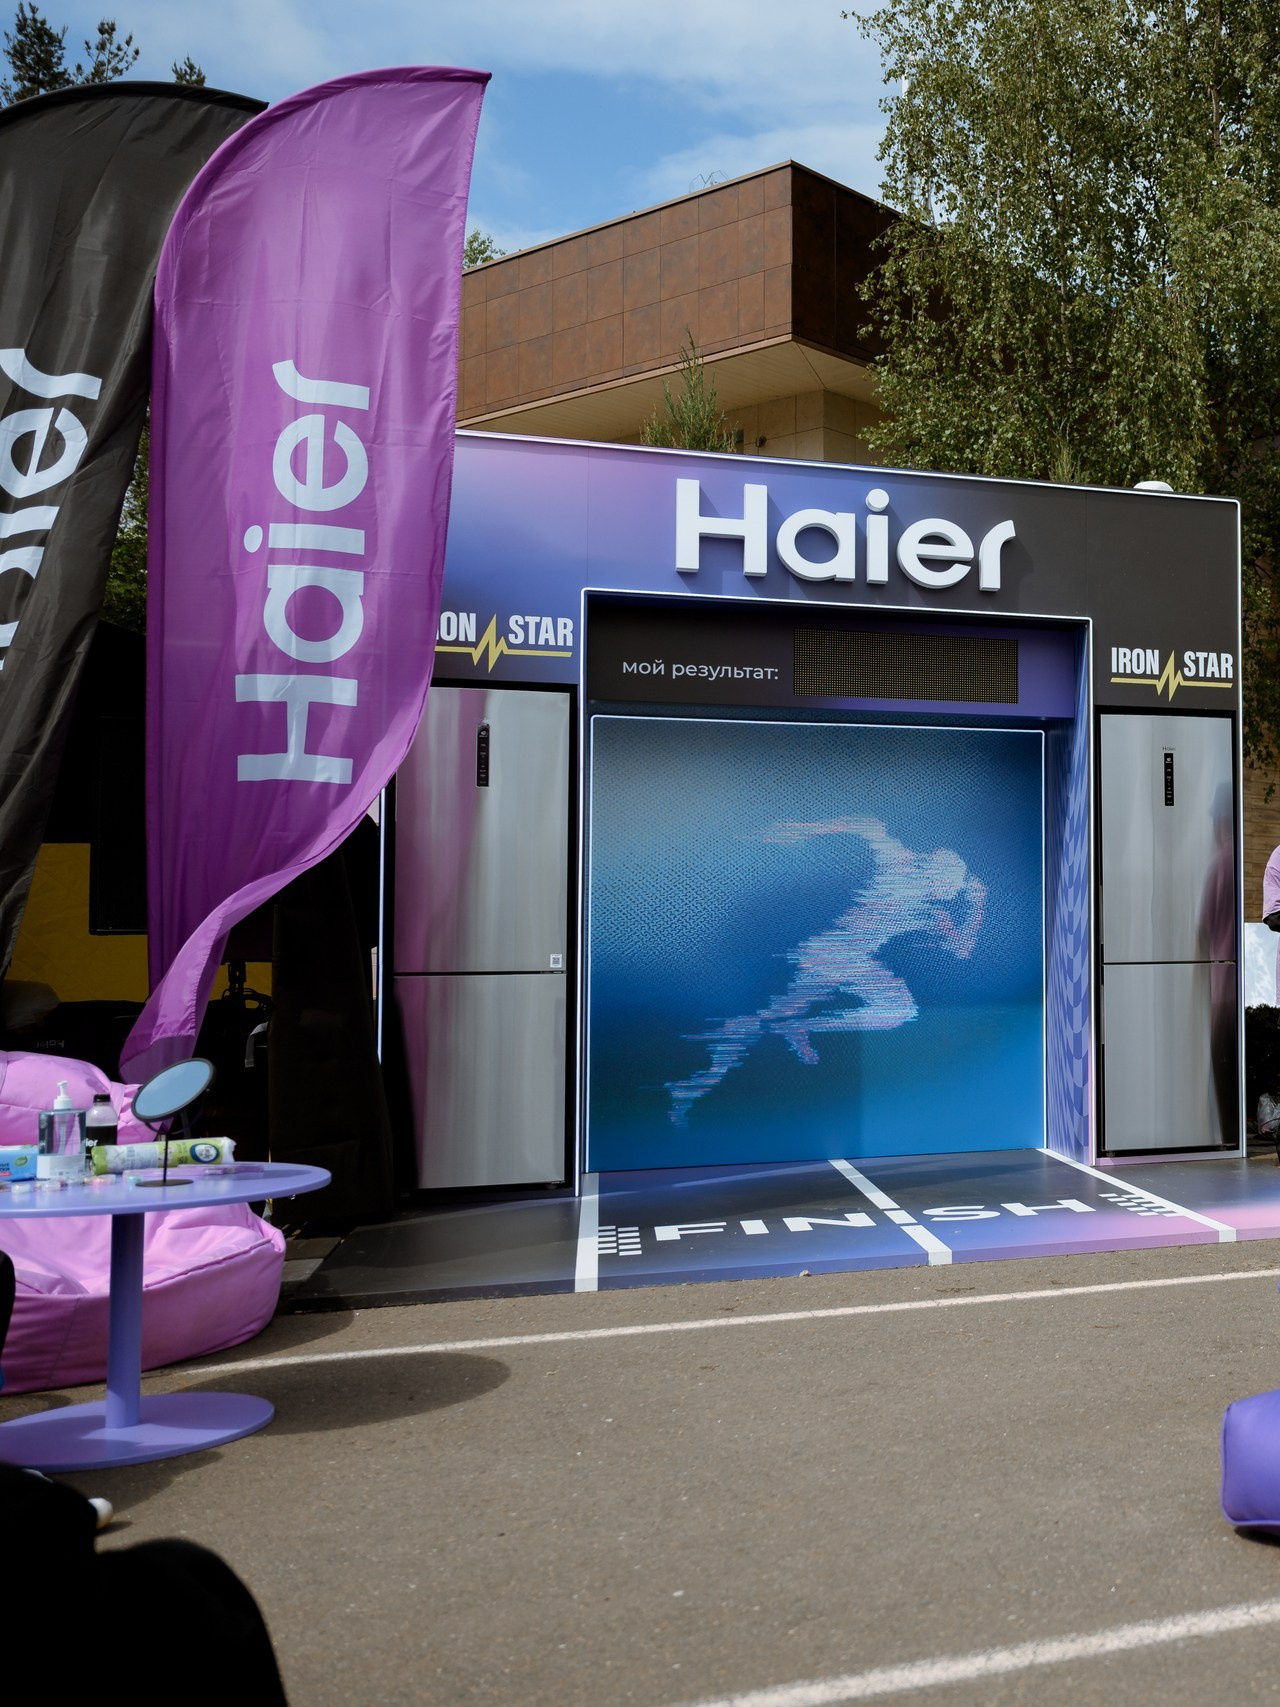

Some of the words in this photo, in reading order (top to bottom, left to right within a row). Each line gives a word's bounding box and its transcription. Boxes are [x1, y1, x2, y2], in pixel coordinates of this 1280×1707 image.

[0, 348, 102, 671] ier
[675, 478, 1017, 592] Haier
[235, 359, 370, 785] Haier
[436, 611, 477, 642] ON
[508, 614, 574, 647] STAR
[622, 659, 665, 675] мой
[672, 663, 779, 681] результат:
[1111, 647, 1160, 676] IRON
[1183, 650, 1234, 679] STAR
[655, 1198, 1097, 1242] FINISH
